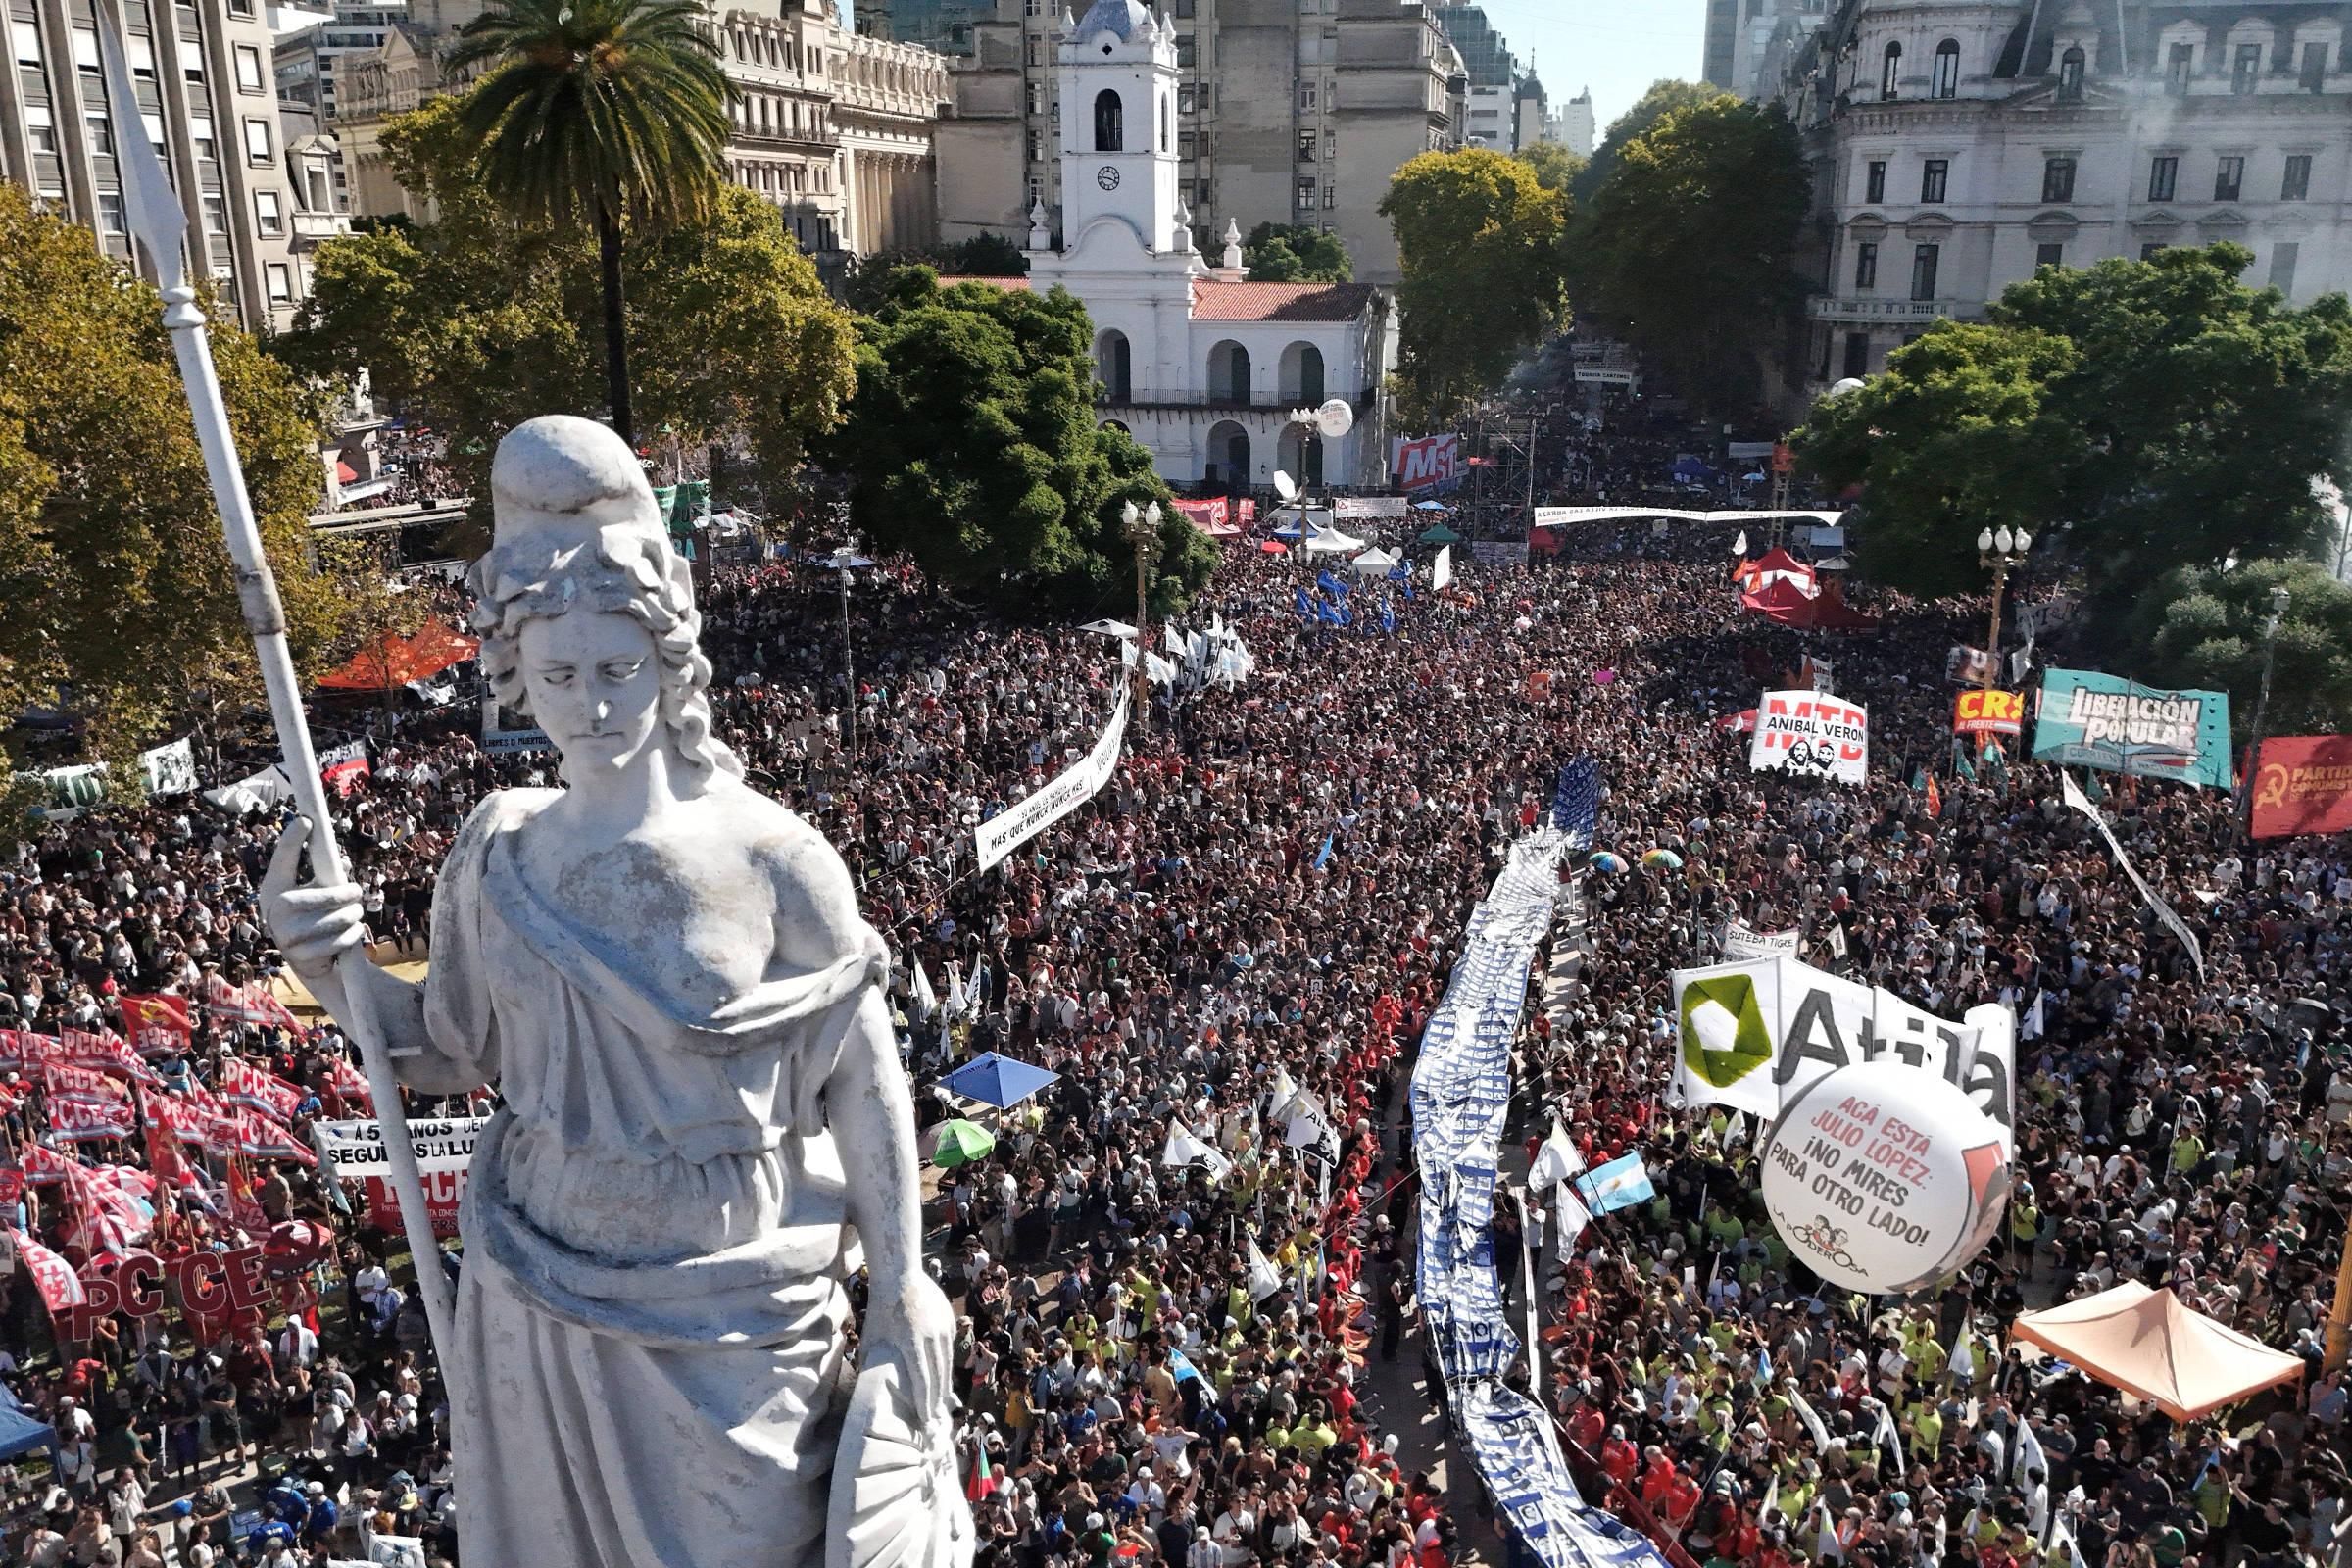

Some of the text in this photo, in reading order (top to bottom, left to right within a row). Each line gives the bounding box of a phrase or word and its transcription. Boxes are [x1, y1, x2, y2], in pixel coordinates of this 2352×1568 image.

[1403, 443, 1456, 483] MST
[2068, 687, 2202, 724] LIBERACIÓN
[517, 736, 547, 745] MUERTOS
[1767, 716, 1864, 742] ANIBAL VERON
[1967, 719, 1995, 729] FRENTE
[2082, 717, 2198, 751] POPULAR
[1009, 821, 1025, 839] QUE
[1026, 805, 1050, 829] NUNCA
[1729, 930, 1795, 948] SUTEBA TIGRE
[355, 1129, 363, 1141] A
[368, 1125, 381, 1141] 5
[1811, 1110, 1864, 1148] JULIO
[1838, 1096, 1933, 1157] ACÁ ESTÁ
[431, 1142, 446, 1157] LA
[1802, 1136, 1909, 1207] ¡NO MIRES
[1771, 1141, 1931, 1247] PARA OTRO LADO!
[1773, 1204, 1786, 1222] LA
[1787, 1222, 1869, 1277] PODEROSA
[72, 1245, 275, 1342] PCCE
